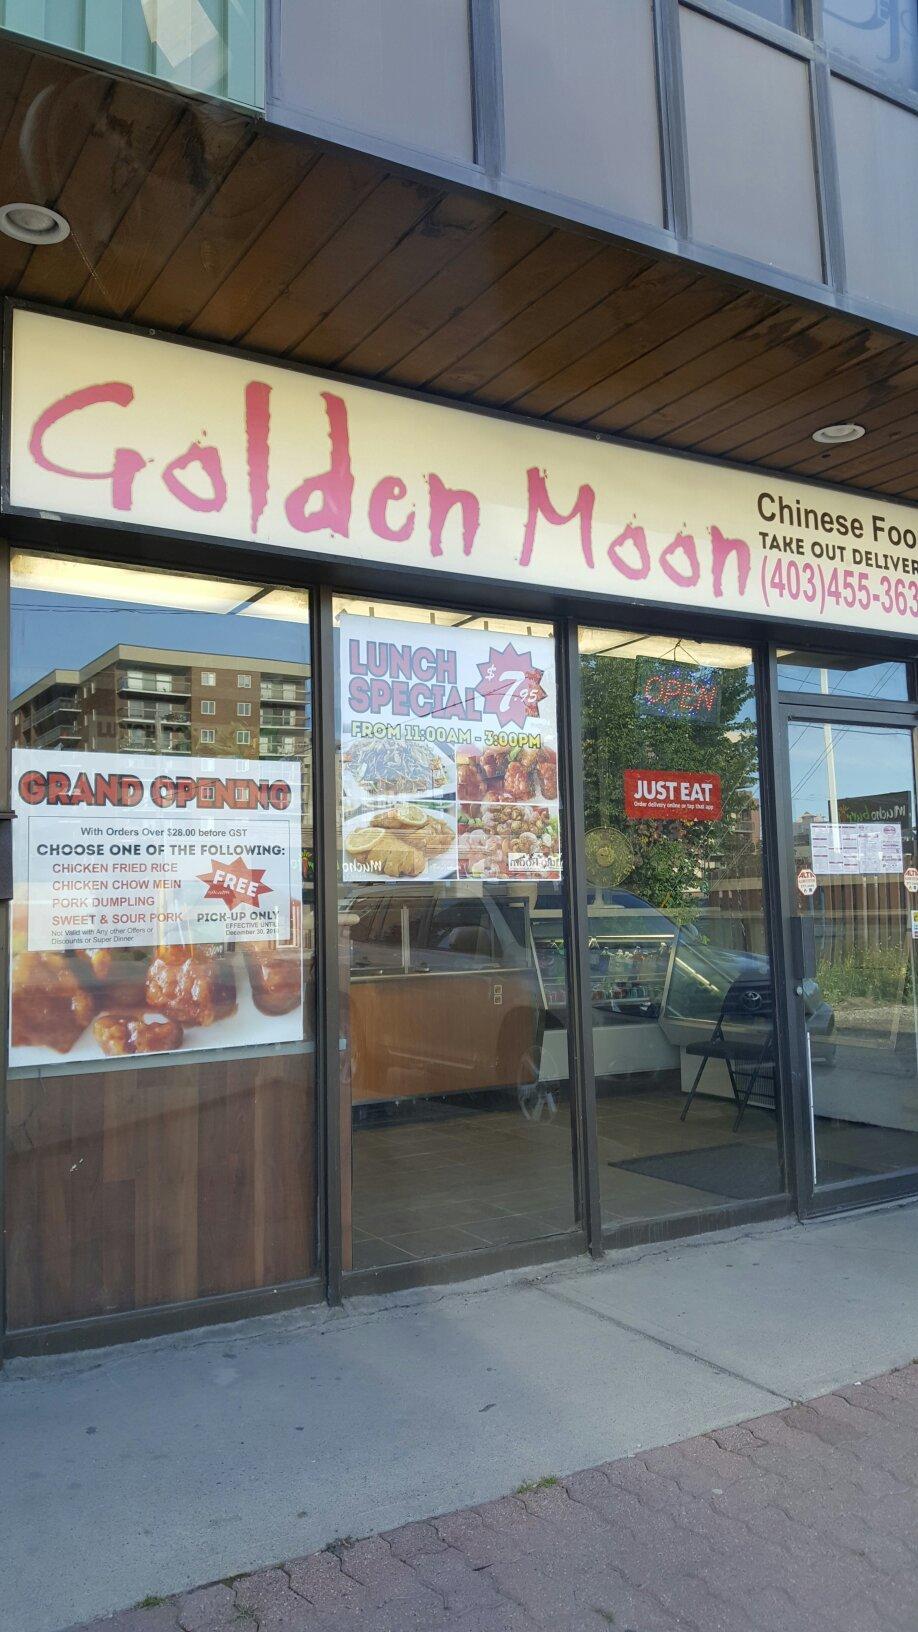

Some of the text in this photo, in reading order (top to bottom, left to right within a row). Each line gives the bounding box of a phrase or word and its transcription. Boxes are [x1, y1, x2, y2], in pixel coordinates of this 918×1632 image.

[29, 380, 751, 598] Golden Moon
[757, 492, 864, 538] Chinese
[758, 531, 805, 556] TAKE
[810, 541, 847, 563] OUT
[349, 638, 458, 685] LUNCH
[347, 676, 483, 722] SPECIAL
[644, 675, 717, 711] OPEN
[350, 720, 402, 740] FROM
[404, 724, 472, 744] 11:00AM
[484, 730, 542, 748] 3:00PM
[18, 770, 292, 811] GRAND OPENING
[633, 780, 713, 801] JUST EAT
[81, 827, 248, 837] With Orders Over $28.00 before GST
[36, 844, 285, 856] CHOOSE ONE OF THE FOLLOWING:
[52, 862, 178, 874] CHICKEN FRIED RICE
[52, 879, 182, 891] CHICKEN CHOW MEIN
[213, 869, 259, 898] FREE
[52, 896, 155, 909] PORK DUMPLING
[52, 912, 183, 927] SWEET & SOUR PORK
[197, 910, 280, 923] PICK-UP ONLY
[51, 937, 83, 945] Discounts
[93, 935, 112, 944] Super
[113, 935, 134, 943] Dinner
[96, 928, 108, 936] Any
[110, 927, 125, 935] other
[225, 928, 256, 936] December
[256, 928, 265, 936] 30,
